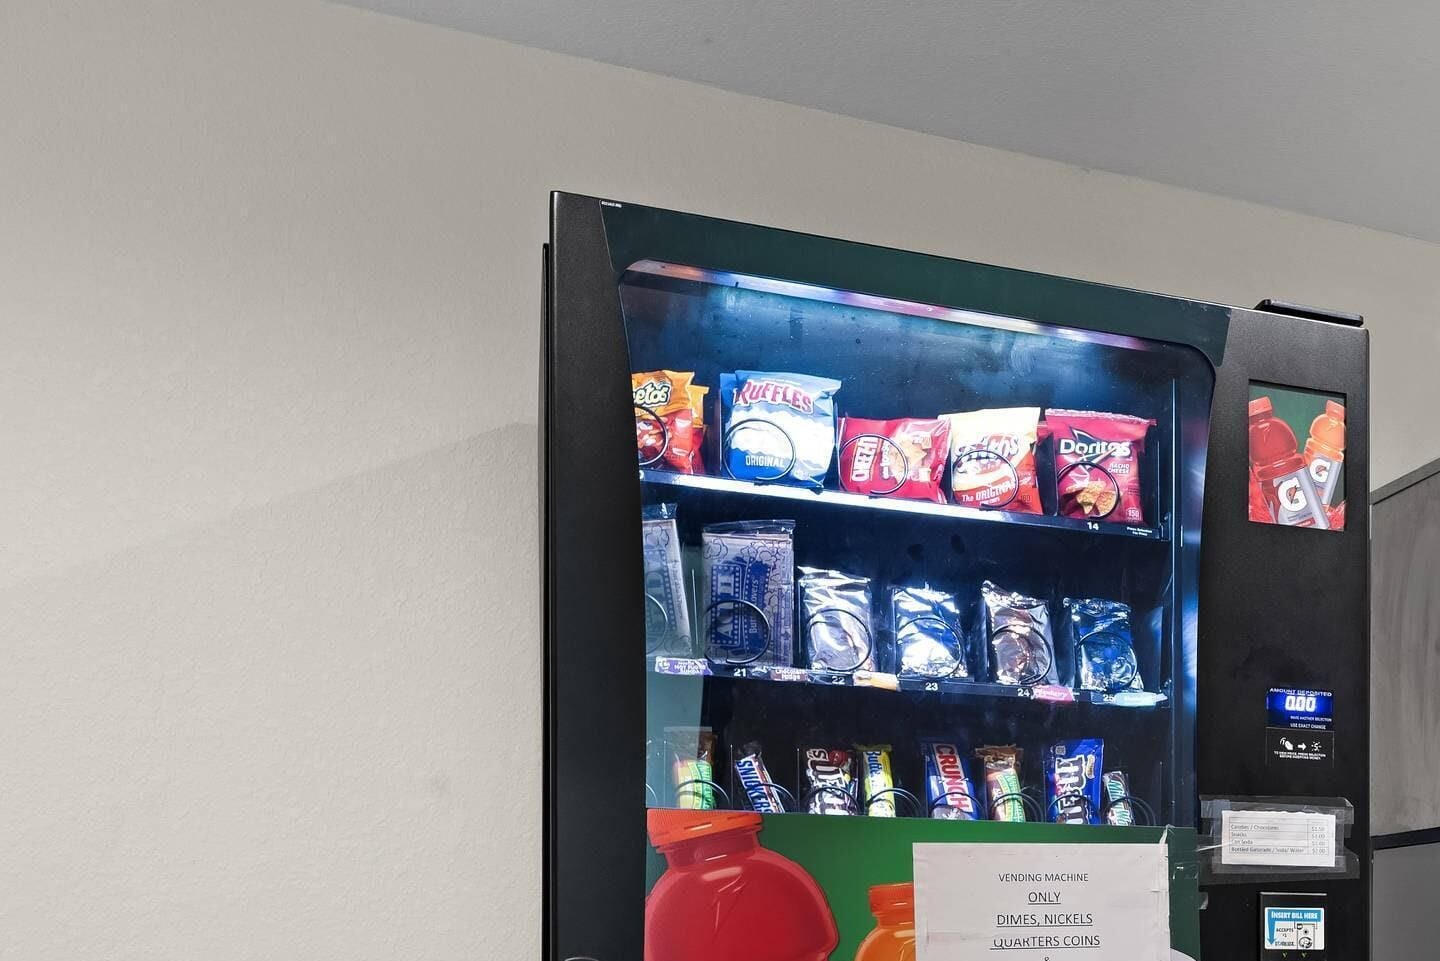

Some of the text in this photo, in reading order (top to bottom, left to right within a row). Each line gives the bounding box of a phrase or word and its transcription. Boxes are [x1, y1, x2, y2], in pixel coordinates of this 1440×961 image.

[735, 378, 813, 414] RUFFLES
[1060, 438, 1131, 458] Doritos
[745, 454, 786, 469] ORIGINAL
[1277, 477, 1308, 512] G
[1087, 522, 1099, 531] 14
[733, 668, 747, 677] 21
[831, 676, 845, 685] 22
[925, 682, 939, 691] 23
[1017, 688, 1031, 697] 24
[1269, 687, 1333, 697] AMOUNT DEPOSITED
[934, 744, 970, 811] CRUNCH
[736, 759, 773, 813] SNICKERS
[998, 872, 1089, 883] VENDING MACHINE
[1027, 891, 1062, 905] ONLY
[996, 913, 1094, 927] DIMES, NICKELS
[1271, 910, 1318, 920] INSERT BILL HERE
[992, 934, 1101, 949] QUARTERS COINS
